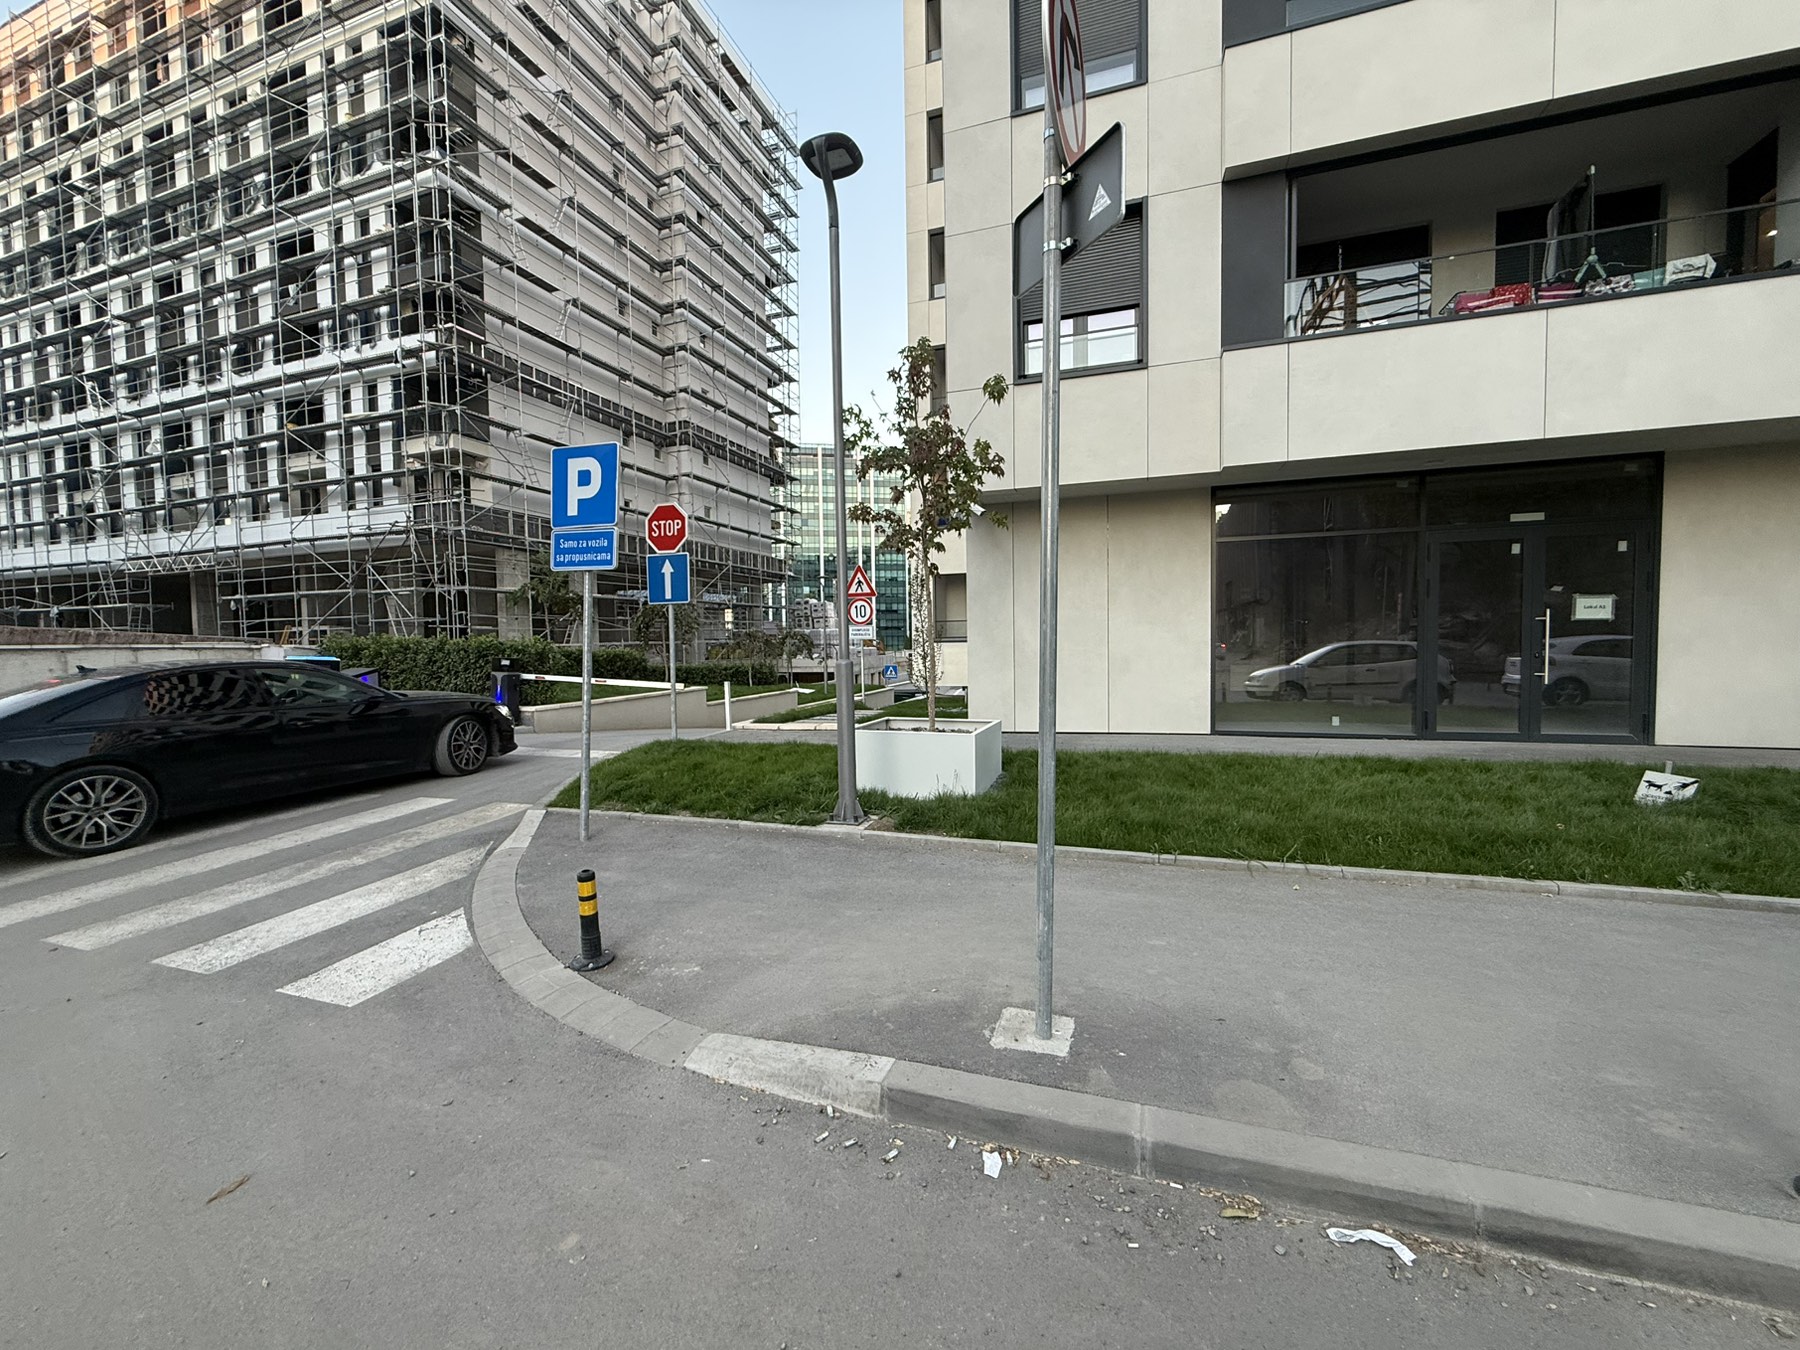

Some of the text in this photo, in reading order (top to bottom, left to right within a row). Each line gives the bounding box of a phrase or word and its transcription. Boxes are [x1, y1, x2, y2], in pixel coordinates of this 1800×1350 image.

[567, 456, 602, 517] P
[651, 519, 682, 537] STOP
[560, 537, 608, 548] Samo za vozila
[556, 552, 611, 564] sa propusnicama
[854, 604, 867, 619] 10
